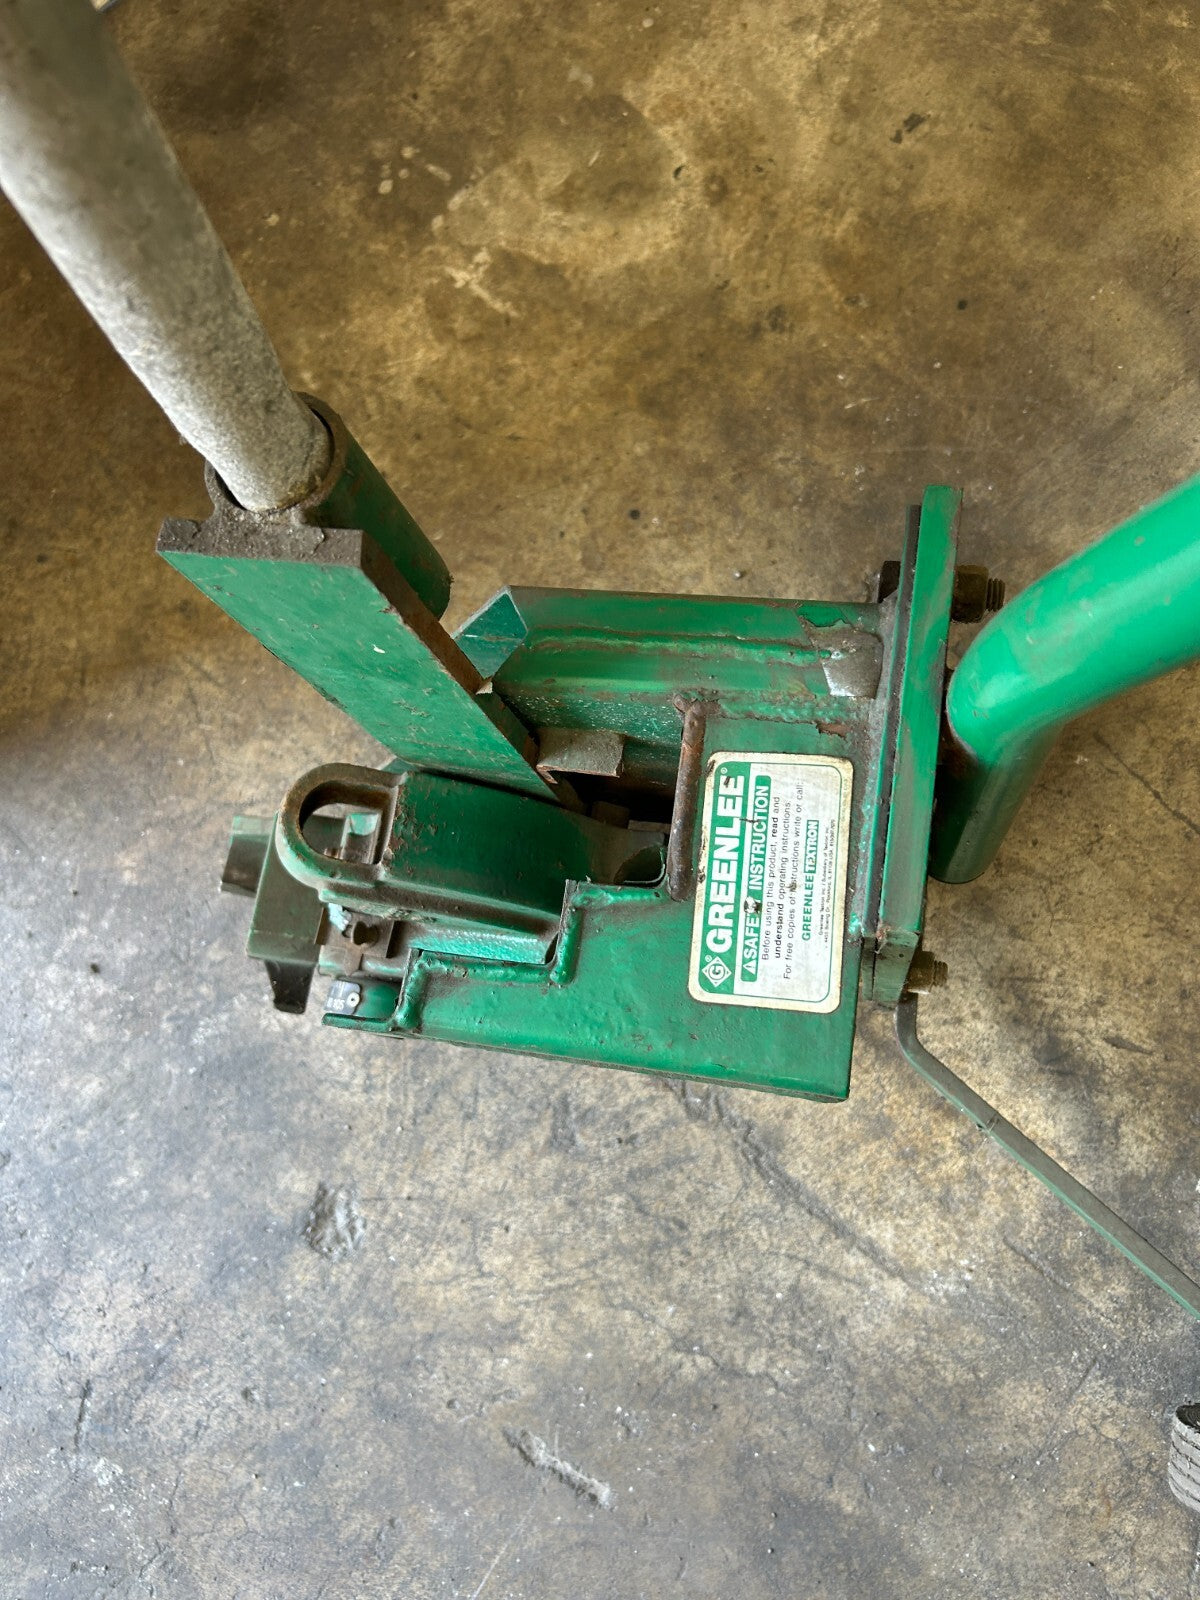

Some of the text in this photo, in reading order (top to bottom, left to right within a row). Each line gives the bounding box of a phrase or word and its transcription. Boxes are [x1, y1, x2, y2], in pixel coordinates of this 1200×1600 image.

[796, 804, 802, 813] or
[771, 817, 779, 838] read
[793, 816, 802, 838] write
[706, 775, 745, 953] GREENLEE
[743, 785, 769, 960] SAFE INSTRUCTION
[768, 841, 777, 878] product,
[789, 841, 801, 893] structions
[766, 881, 774, 898] this
[778, 856, 789, 900] operating
[801, 821, 819, 941] GREENLEE TEXTRON
[765, 901, 774, 926] using
[789, 896, 796, 905] of
[774, 903, 784, 959] understand
[787, 909, 796, 939] copies
[762, 930, 771, 960] Before
[785, 942, 793, 960] free
[783, 964, 792, 979] For
